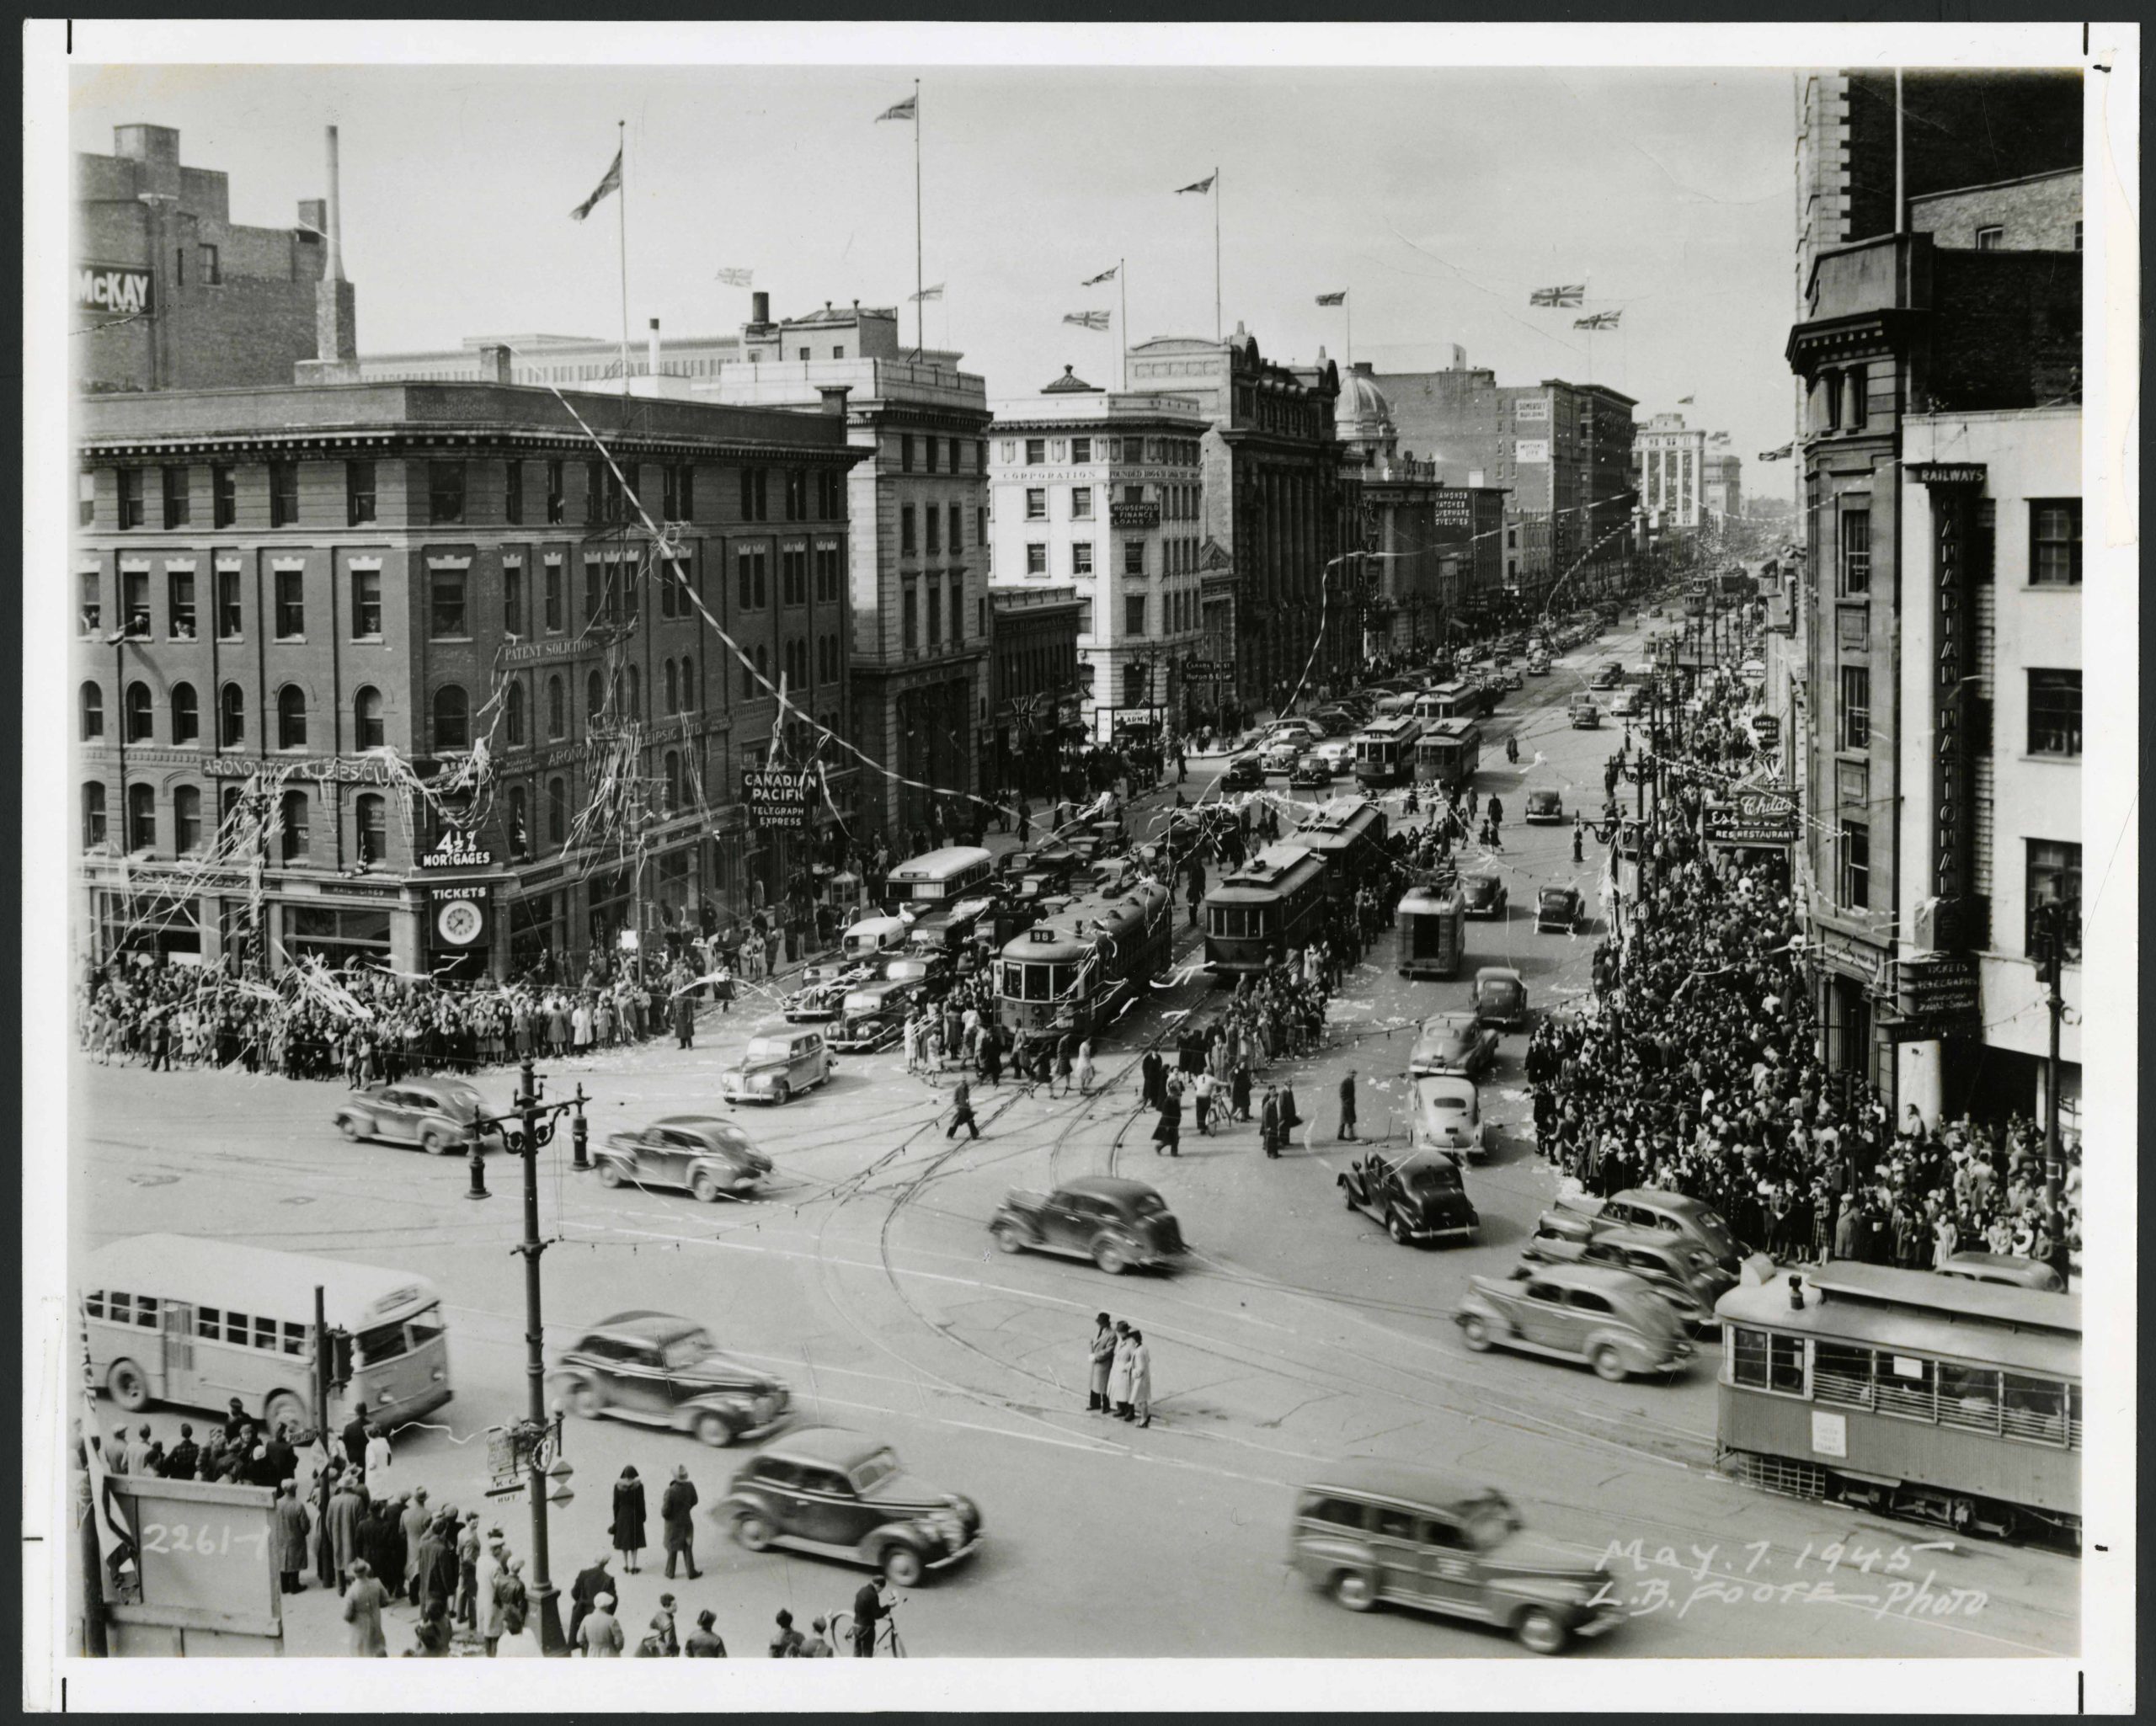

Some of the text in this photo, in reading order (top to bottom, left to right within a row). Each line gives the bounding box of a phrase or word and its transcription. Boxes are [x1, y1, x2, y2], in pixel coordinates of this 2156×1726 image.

[1003, 471, 1096, 480] CORPORATION
[1921, 469, 1985, 482] RAILWAYS
[1436, 491, 1468, 499] AMONDS
[1435, 518, 1469, 526] OVELTIES
[505, 643, 542, 662] PATENT
[1126, 715, 1150, 724] ARMY
[744, 774, 817, 788] CANADIAN
[1740, 796, 1793, 817] Childs
[1939, 710, 1957, 896] NATIONAL
[752, 806, 804, 816] TELEGRAPH
[760, 817, 802, 826] EXPRESS
[1737, 829, 1795, 839] RESTAURANT
[432, 887, 487, 900] TICKETS
[497, 1494, 516, 1504] HUT
